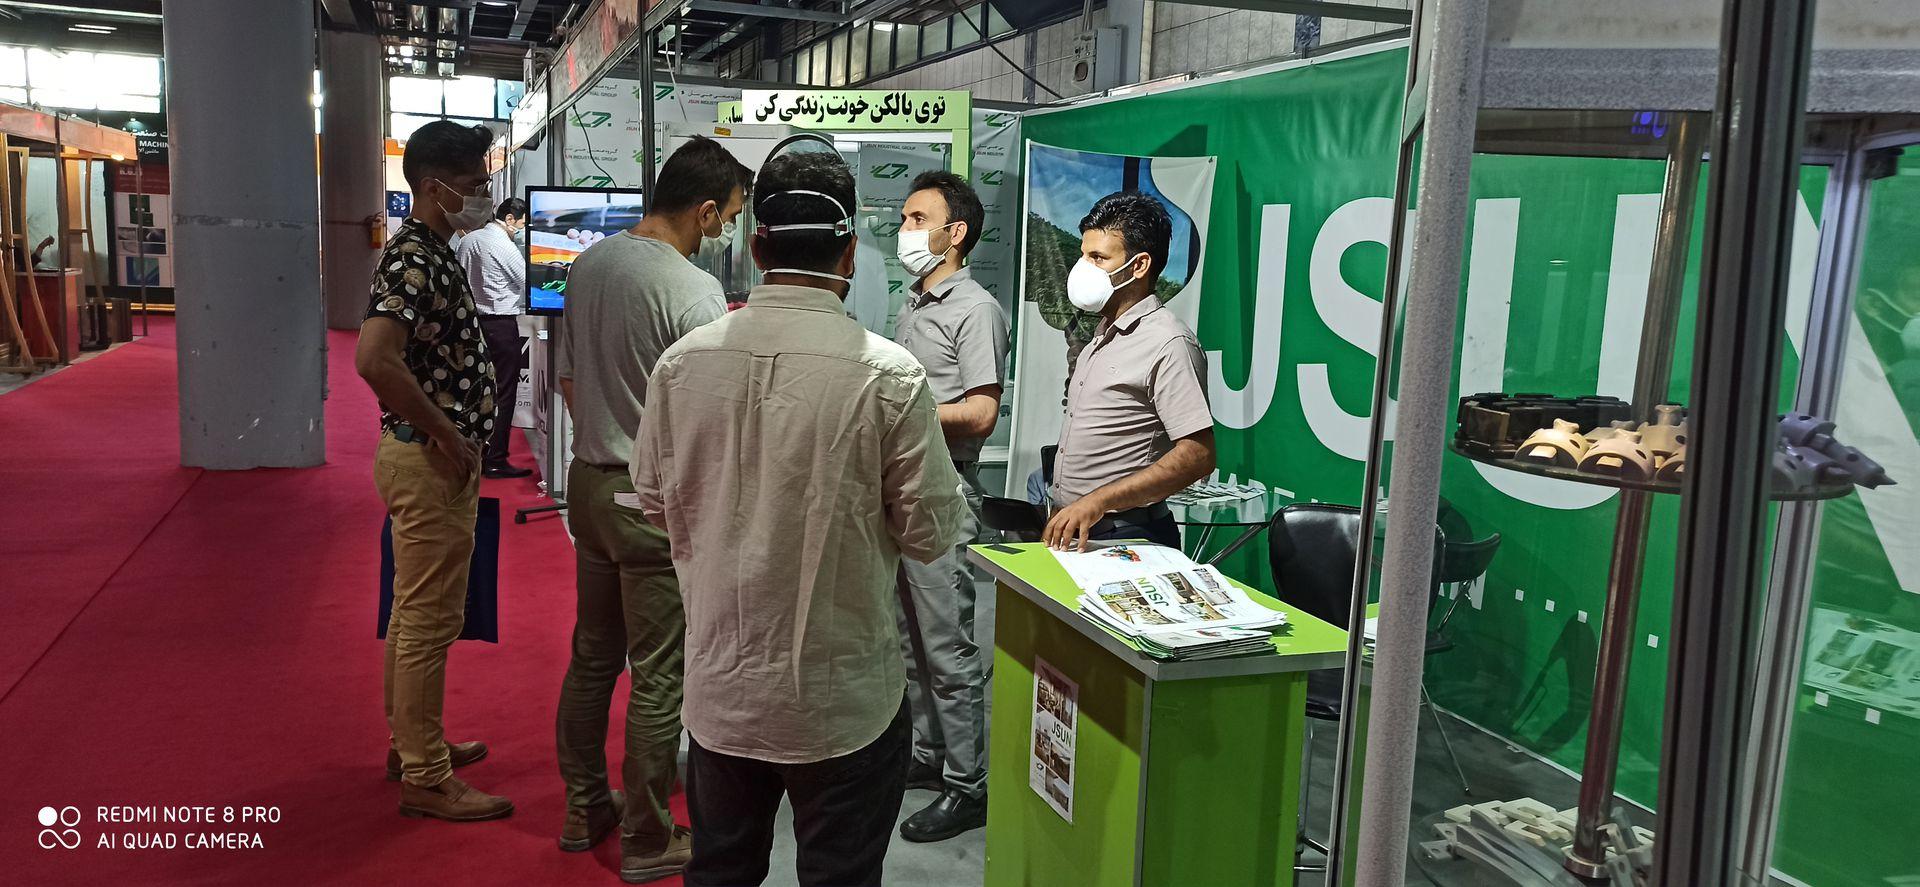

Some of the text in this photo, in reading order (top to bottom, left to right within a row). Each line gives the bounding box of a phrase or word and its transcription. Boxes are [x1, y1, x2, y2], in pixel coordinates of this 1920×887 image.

[755, 92, 946, 124] توی بالکن خونت زندگی کن
[1134, 576, 1170, 607] JSUN
[1051, 720, 1072, 748] JSUN
